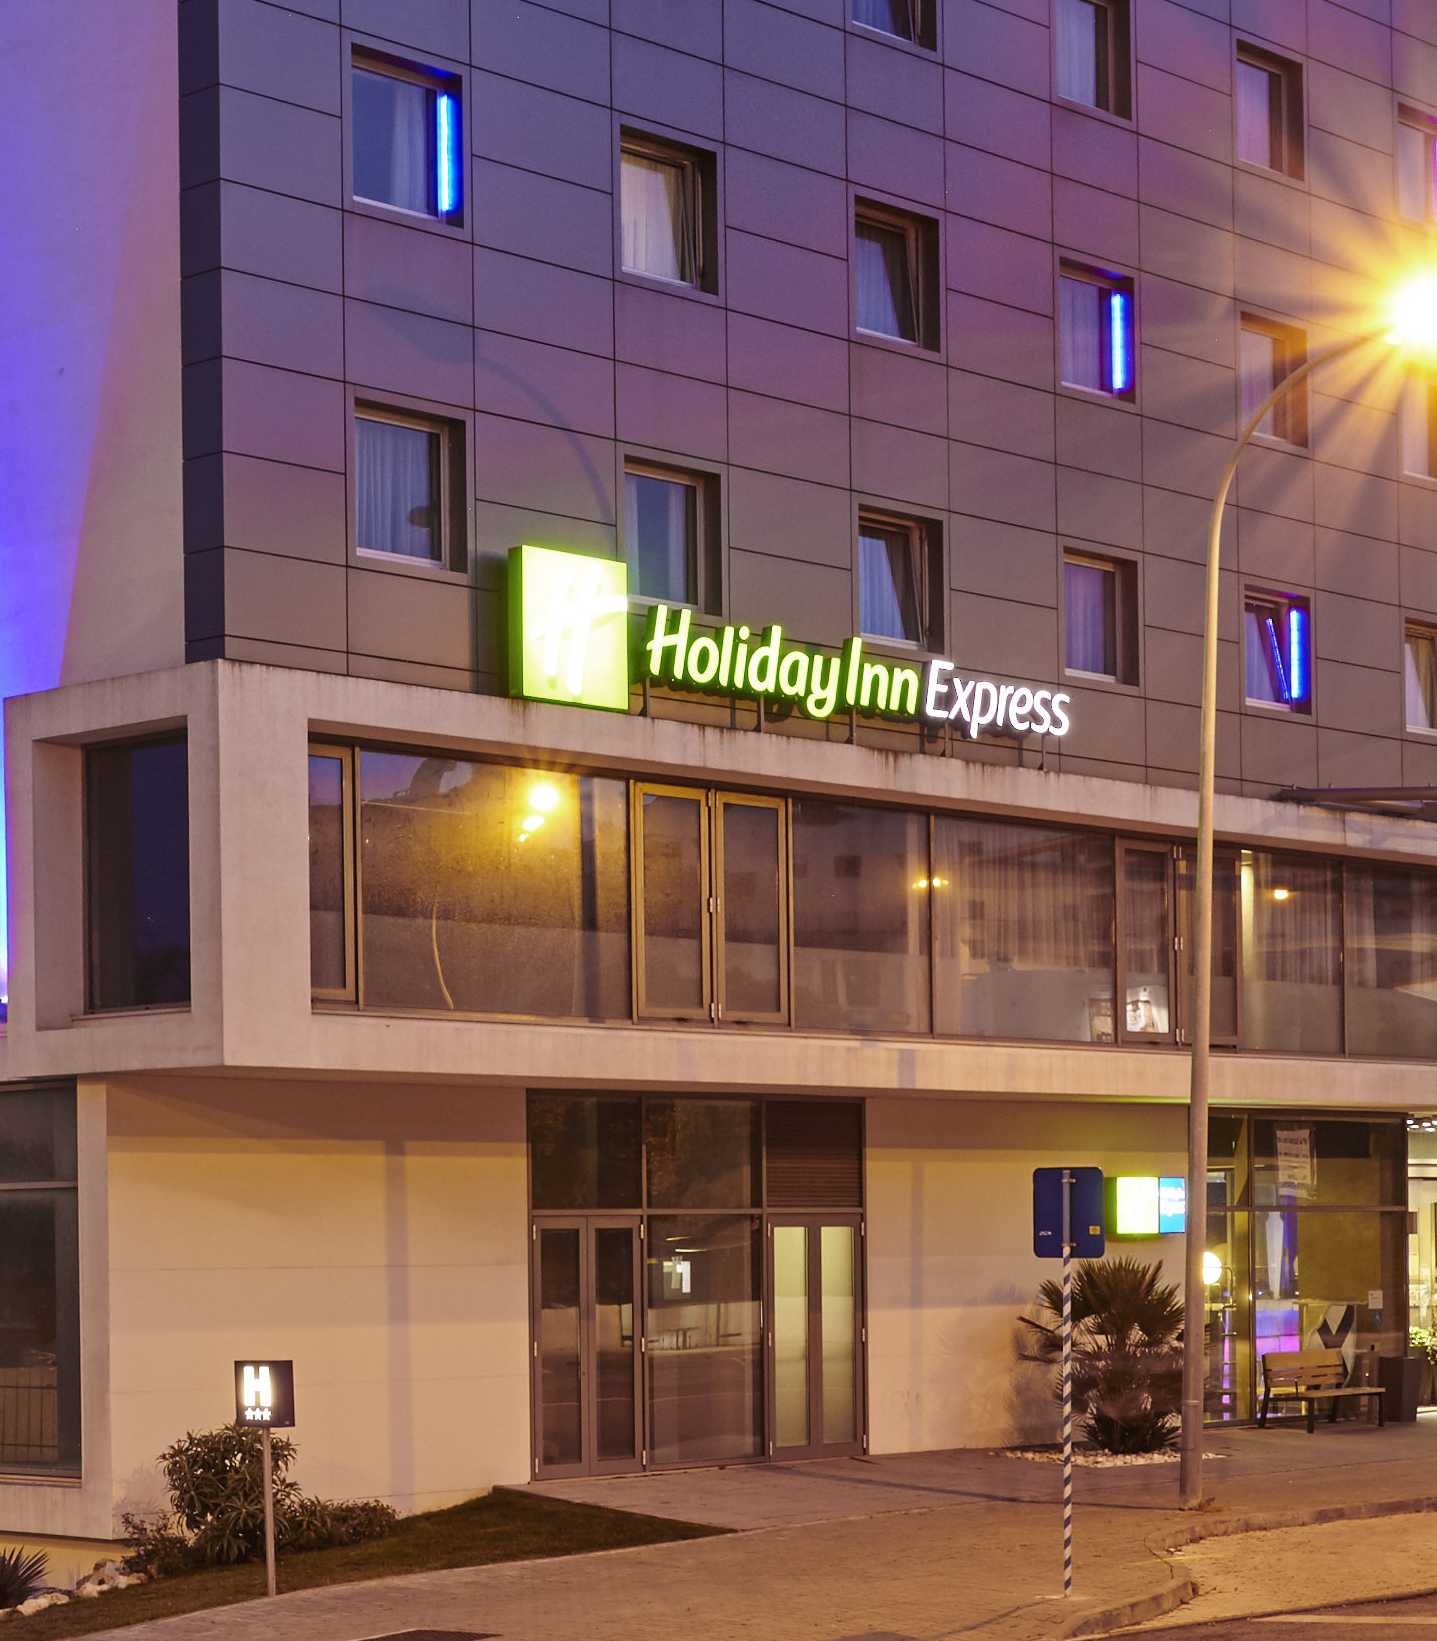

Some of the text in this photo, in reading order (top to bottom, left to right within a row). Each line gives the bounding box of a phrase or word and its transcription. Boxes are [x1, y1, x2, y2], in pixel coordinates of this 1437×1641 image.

[646, 603, 1071, 740] Holiday Inn Express
[243, 1365, 271, 1407] H
